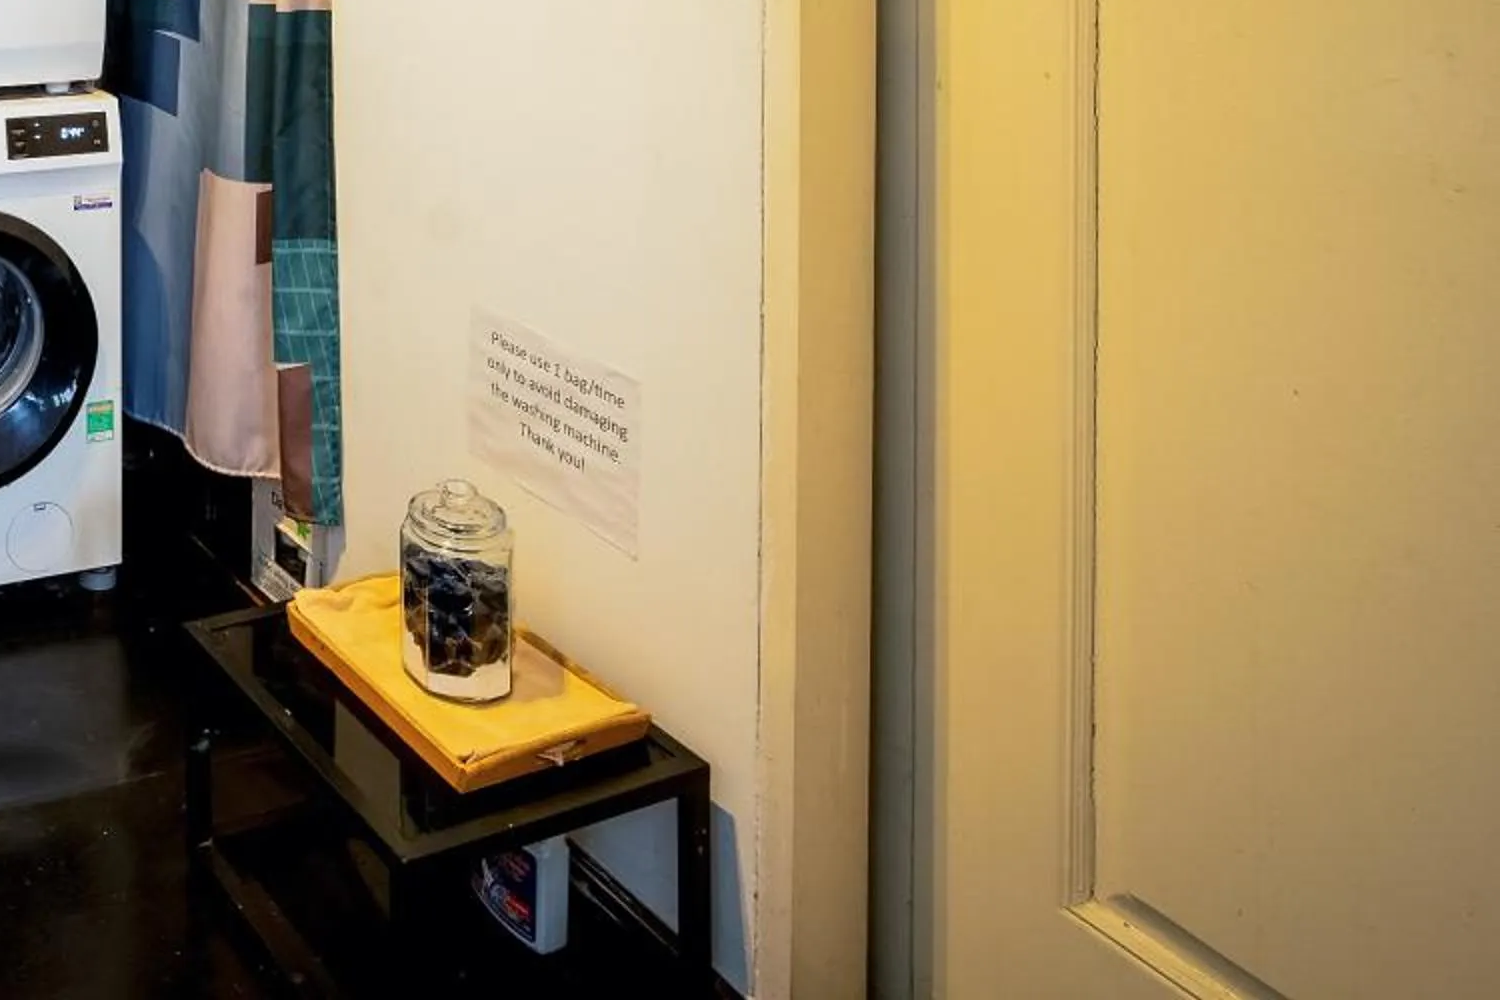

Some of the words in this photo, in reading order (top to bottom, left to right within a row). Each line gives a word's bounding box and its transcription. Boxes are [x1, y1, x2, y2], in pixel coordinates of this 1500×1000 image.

[487, 356, 511, 380] only
[513, 368, 526, 385] to
[529, 379, 561, 404] avoid
[563, 395, 628, 443] damaging
[491, 331, 527, 361] Please
[530, 354, 551, 373] use
[563, 367, 625, 408] bag/time
[490, 381, 509, 403] the
[512, 395, 562, 433] washing
[563, 423, 621, 465] machine.
[519, 420, 555, 455] Thank
[557, 447, 585, 474] you!
